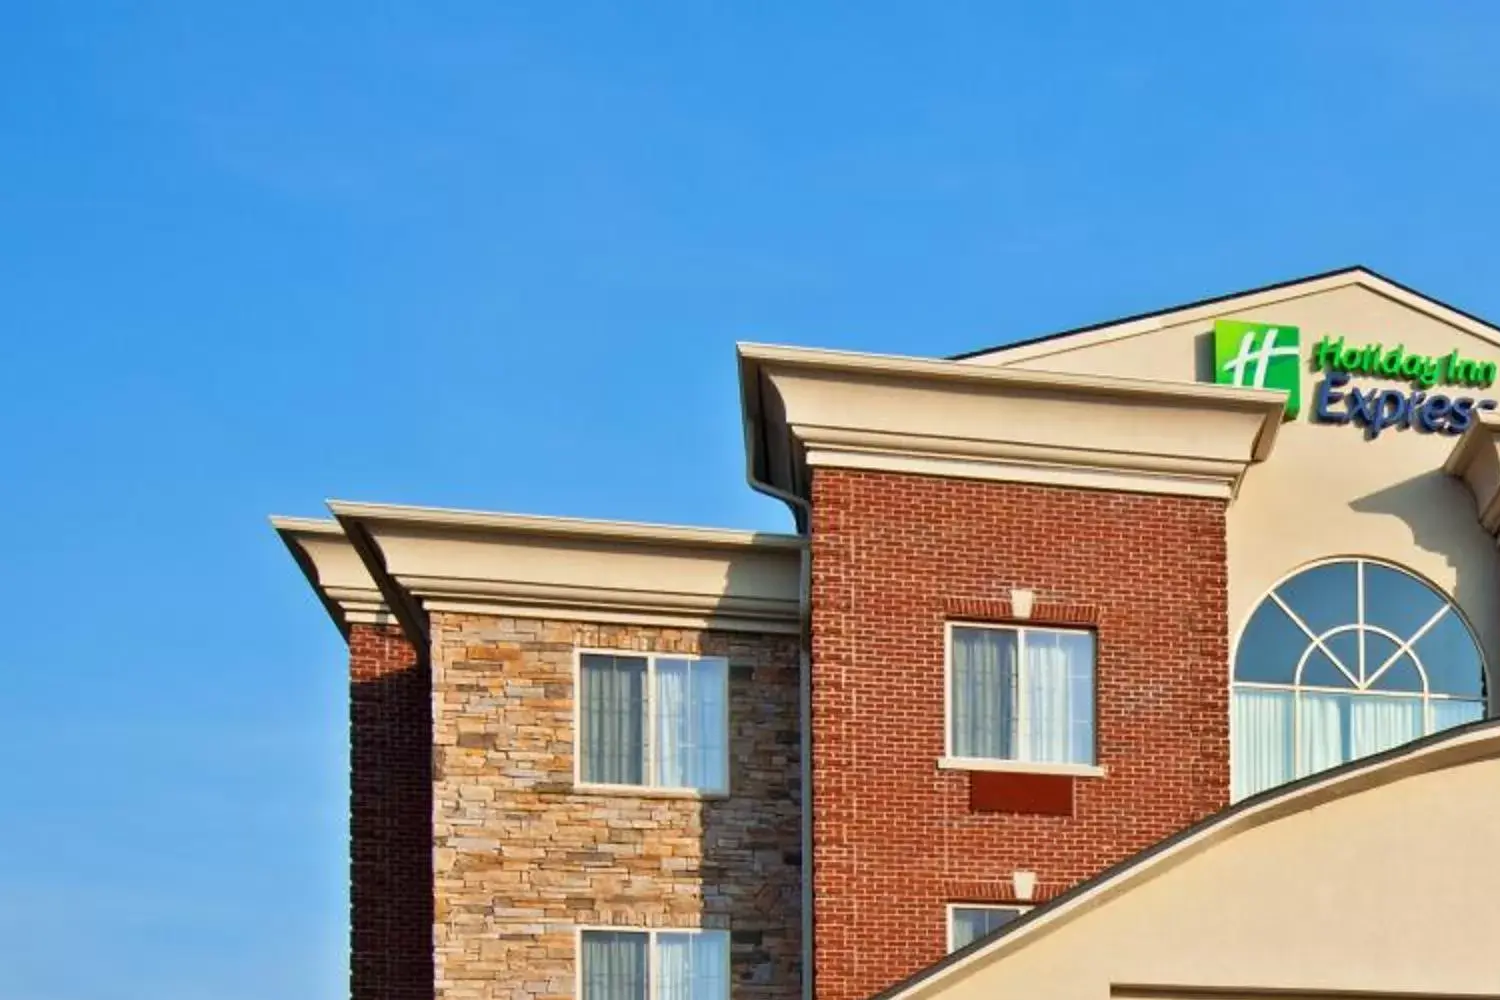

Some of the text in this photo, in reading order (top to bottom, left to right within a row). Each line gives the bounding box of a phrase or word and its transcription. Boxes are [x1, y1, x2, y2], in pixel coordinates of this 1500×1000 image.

[1315, 336, 1497, 388] Holiday Inn
[1317, 371, 1498, 440] Expres
